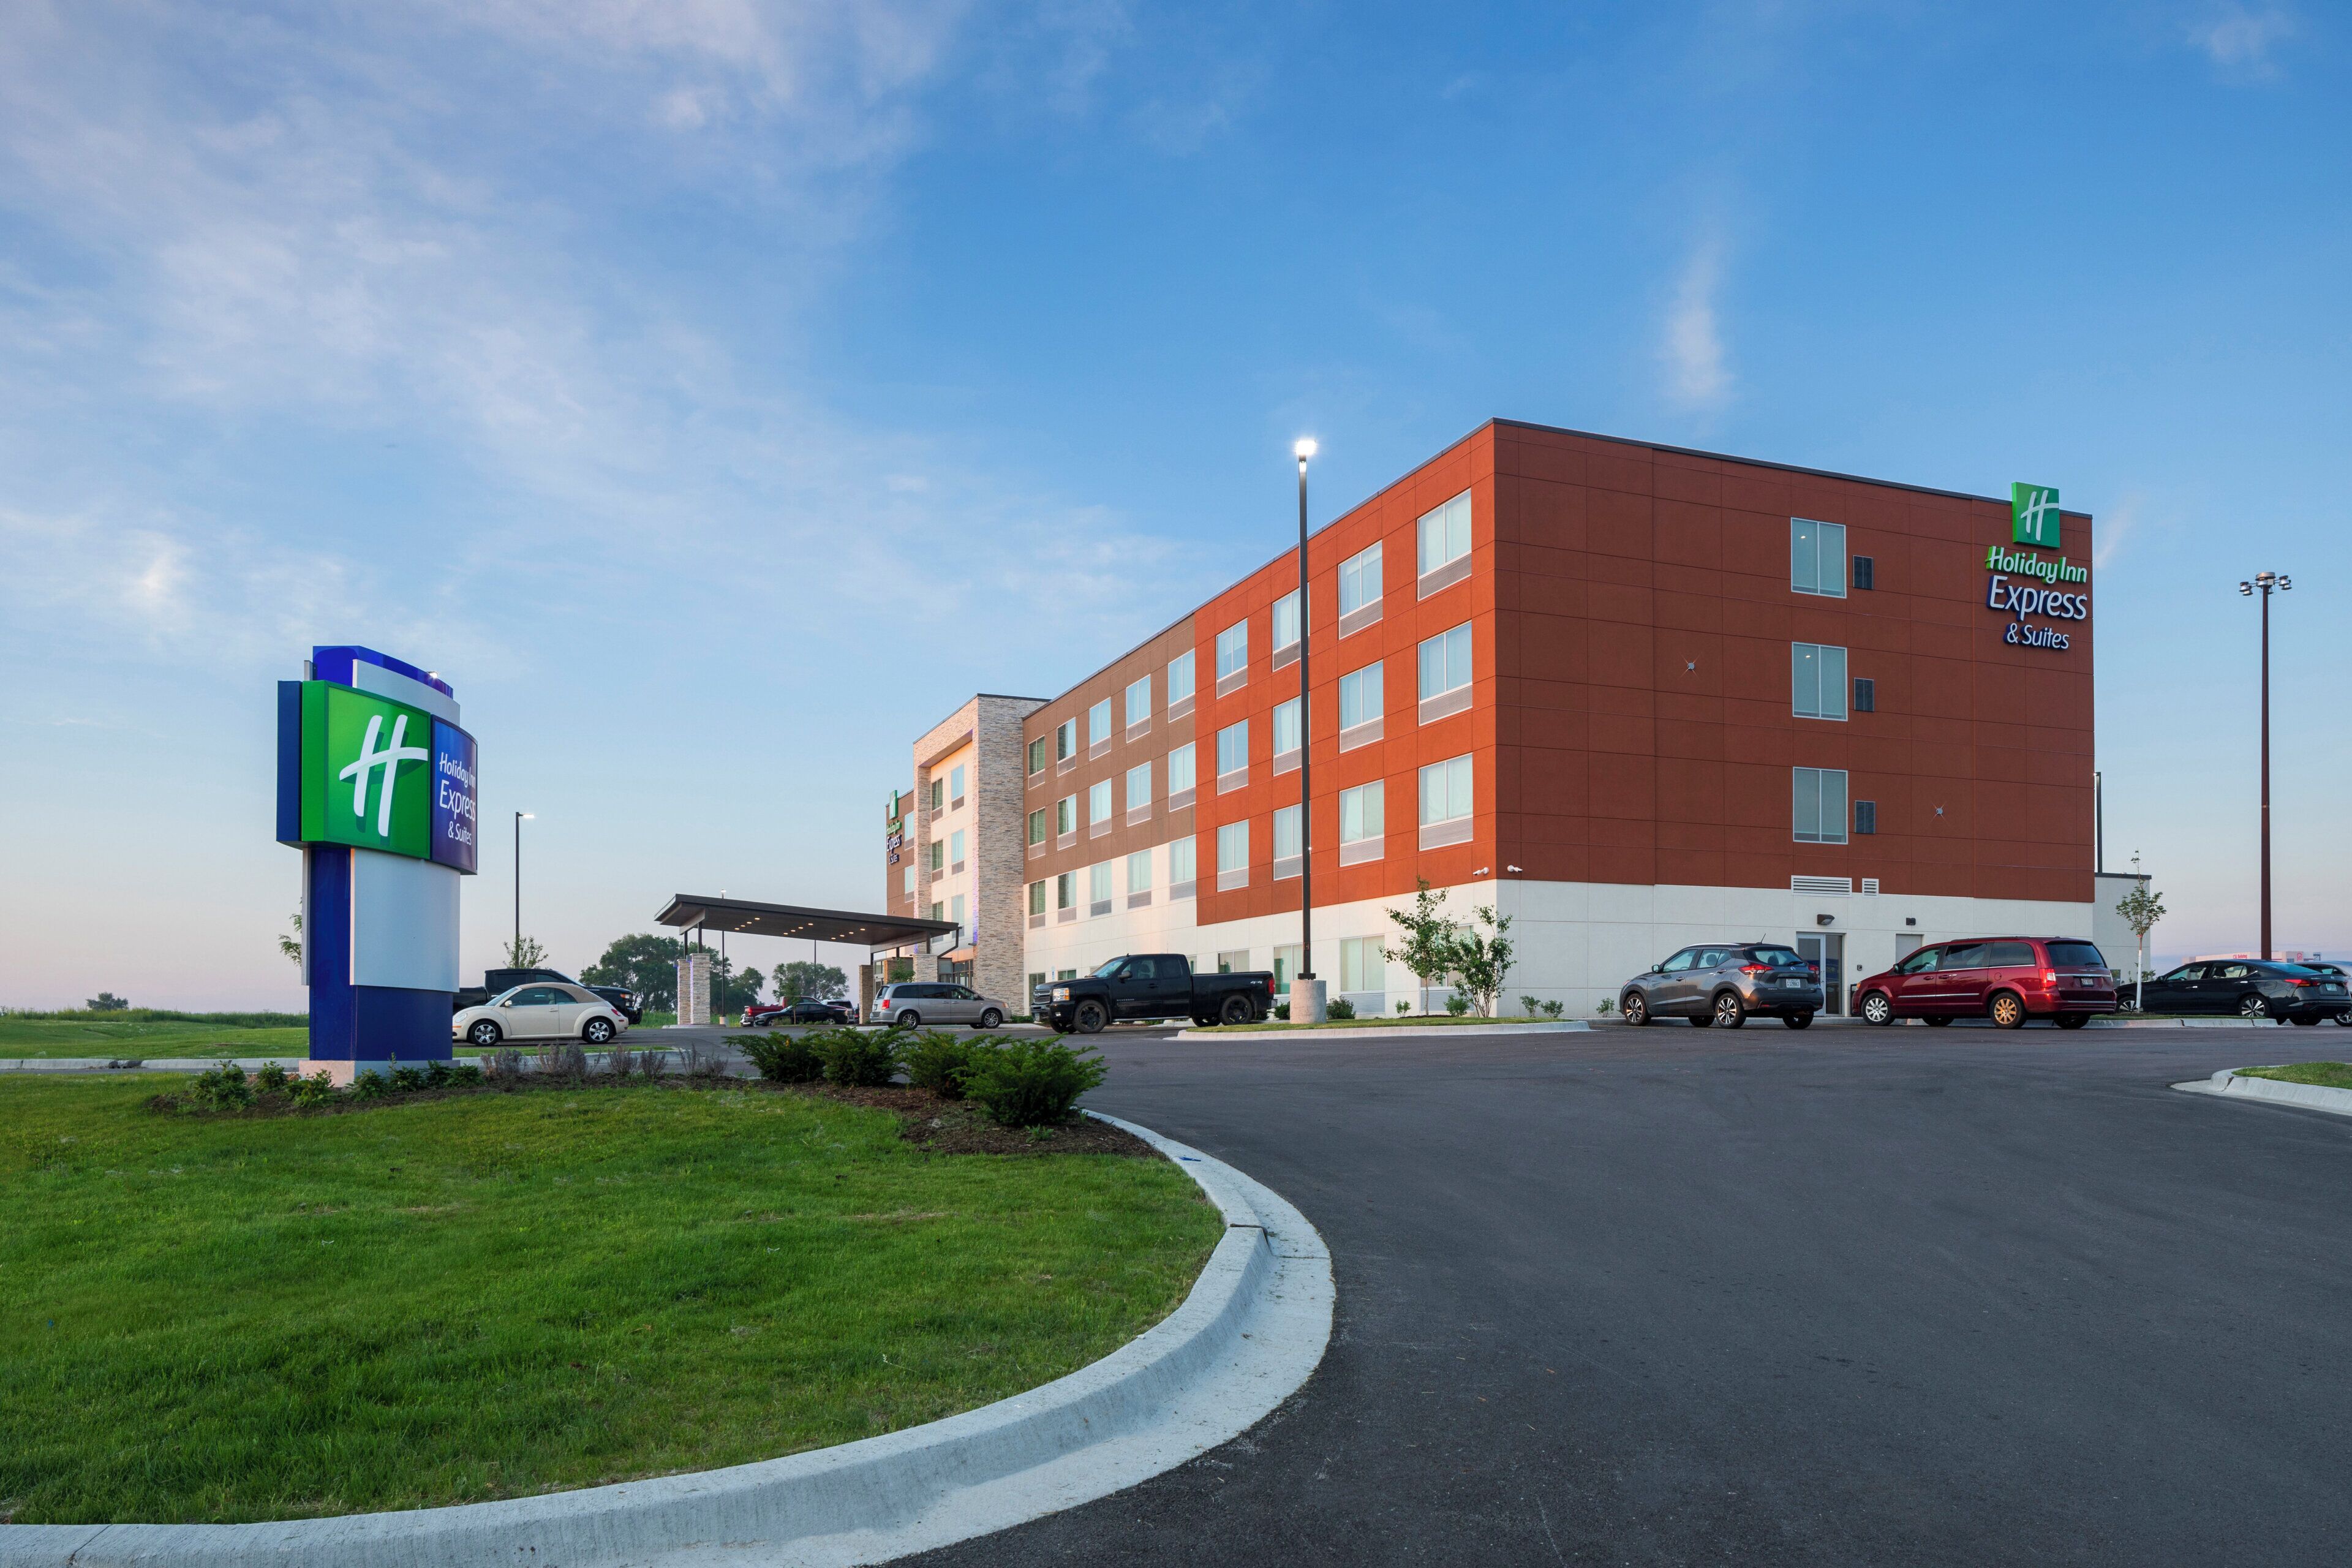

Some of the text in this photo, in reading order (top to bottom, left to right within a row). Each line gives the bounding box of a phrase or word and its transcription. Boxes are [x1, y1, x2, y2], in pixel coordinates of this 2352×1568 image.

[1988, 546, 2087, 584] Holiday Inn
[1989, 575, 2087, 621] Express
[2007, 622, 2070, 649] & Suites
[439, 752, 469, 788] Holiday
[439, 779, 476, 821] Express
[448, 821, 472, 845] & Suites
